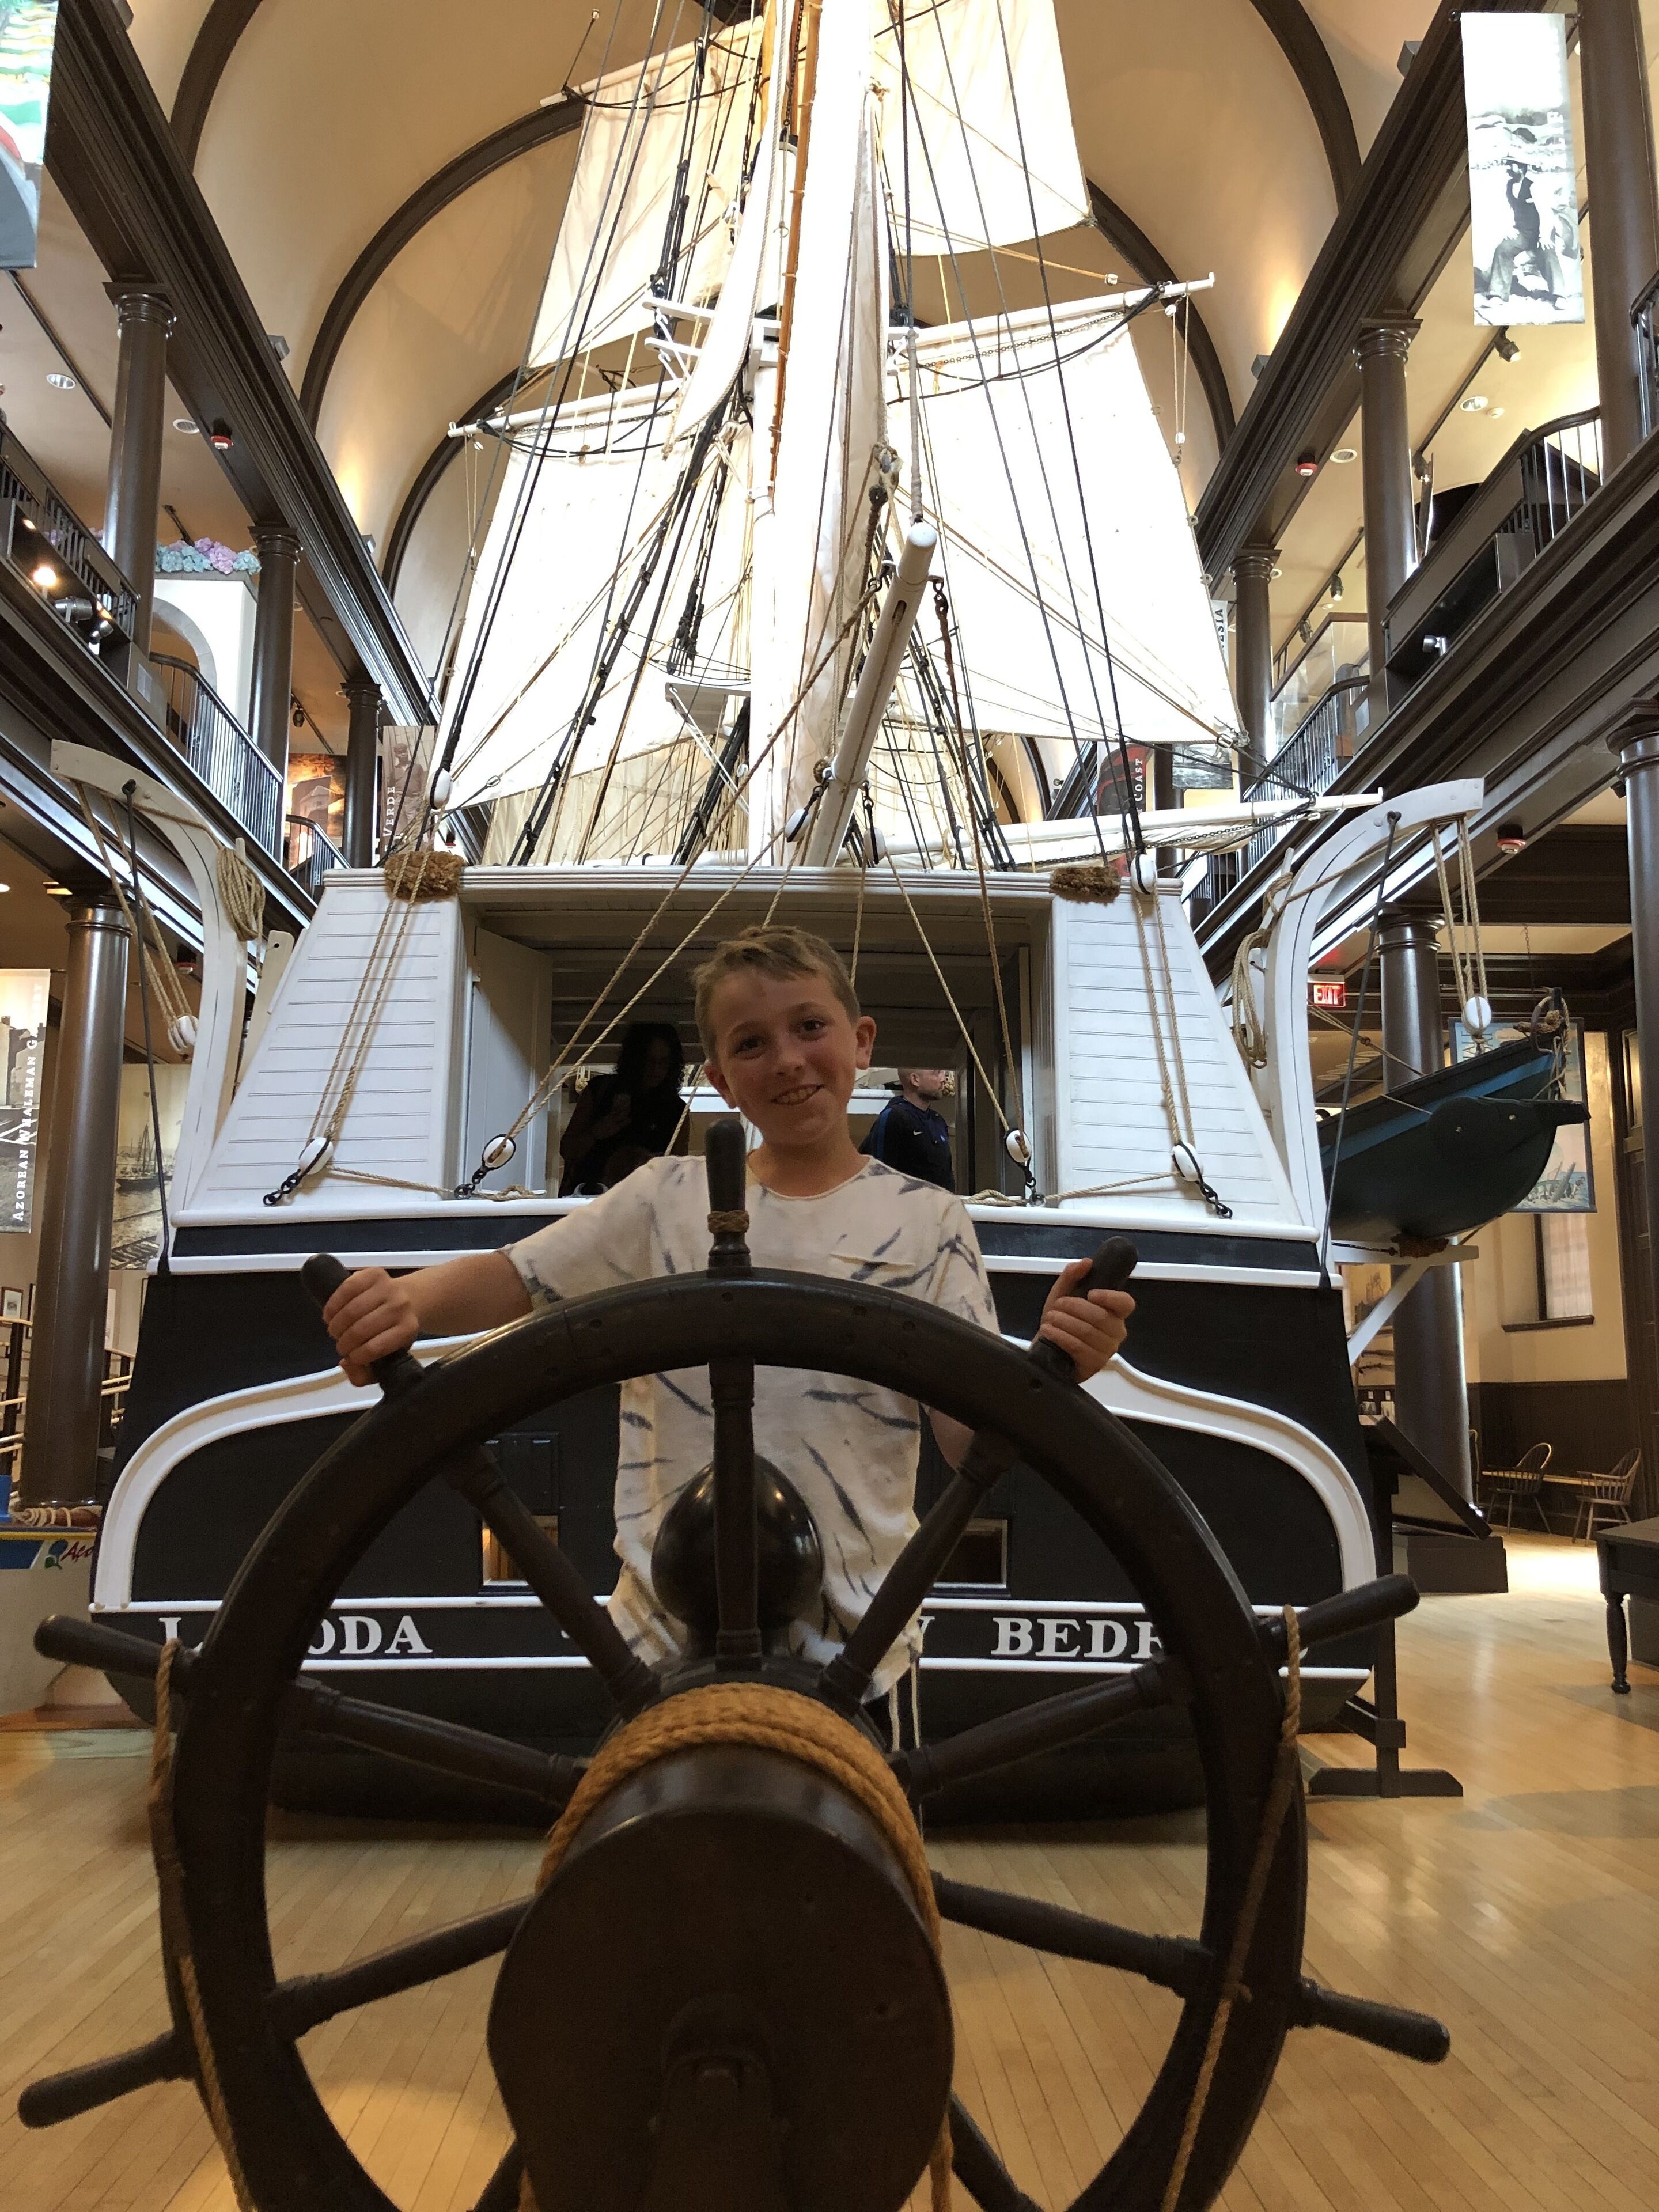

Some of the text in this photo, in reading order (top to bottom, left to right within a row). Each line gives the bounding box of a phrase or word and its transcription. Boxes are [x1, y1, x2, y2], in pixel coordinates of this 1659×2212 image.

[1215, 609, 1225, 649] ESIA
[1134, 758, 1143, 802] COAST
[382, 786, 396, 837] VERDE
[1313, 984, 1340, 1005] EXIT
[19, 1056, 36, 1143] WHALEMAN
[12, 1149, 29, 1221] AZOREAN
